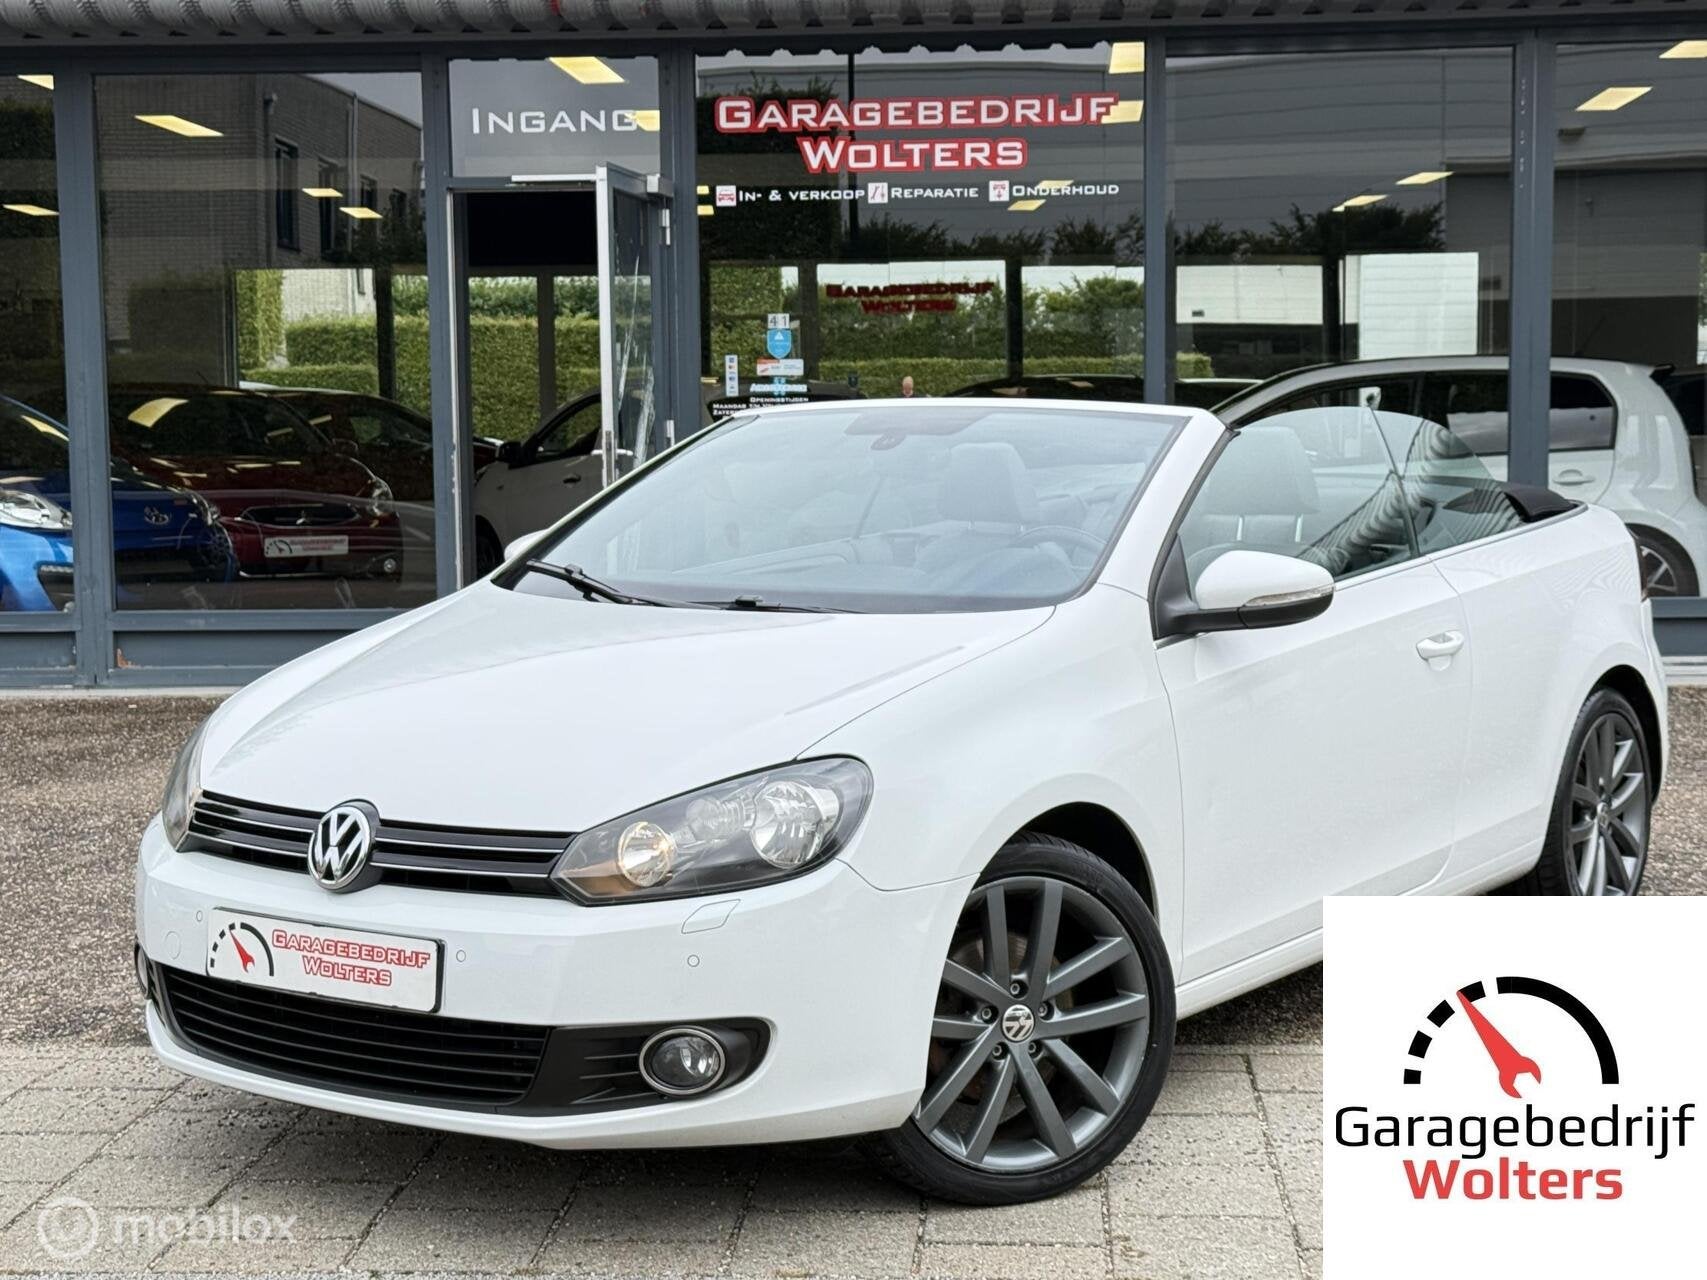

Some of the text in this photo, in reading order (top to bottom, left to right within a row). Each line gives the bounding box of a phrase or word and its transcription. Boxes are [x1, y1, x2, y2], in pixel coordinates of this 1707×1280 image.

[472, 107, 638, 135] INGANG
[715, 94, 1119, 133] GARAGEBEDRIJF
[797, 135, 1028, 174] WOLTERS
[738, 189, 866, 202] IN- & VERKOOP
[890, 187, 979, 199] REPARATIE
[1012, 183, 1120, 196] ONDERHOUD
[272, 928, 430, 968] GARAGEBEDRIJF
[302, 955, 392, 987] WOLTERS
